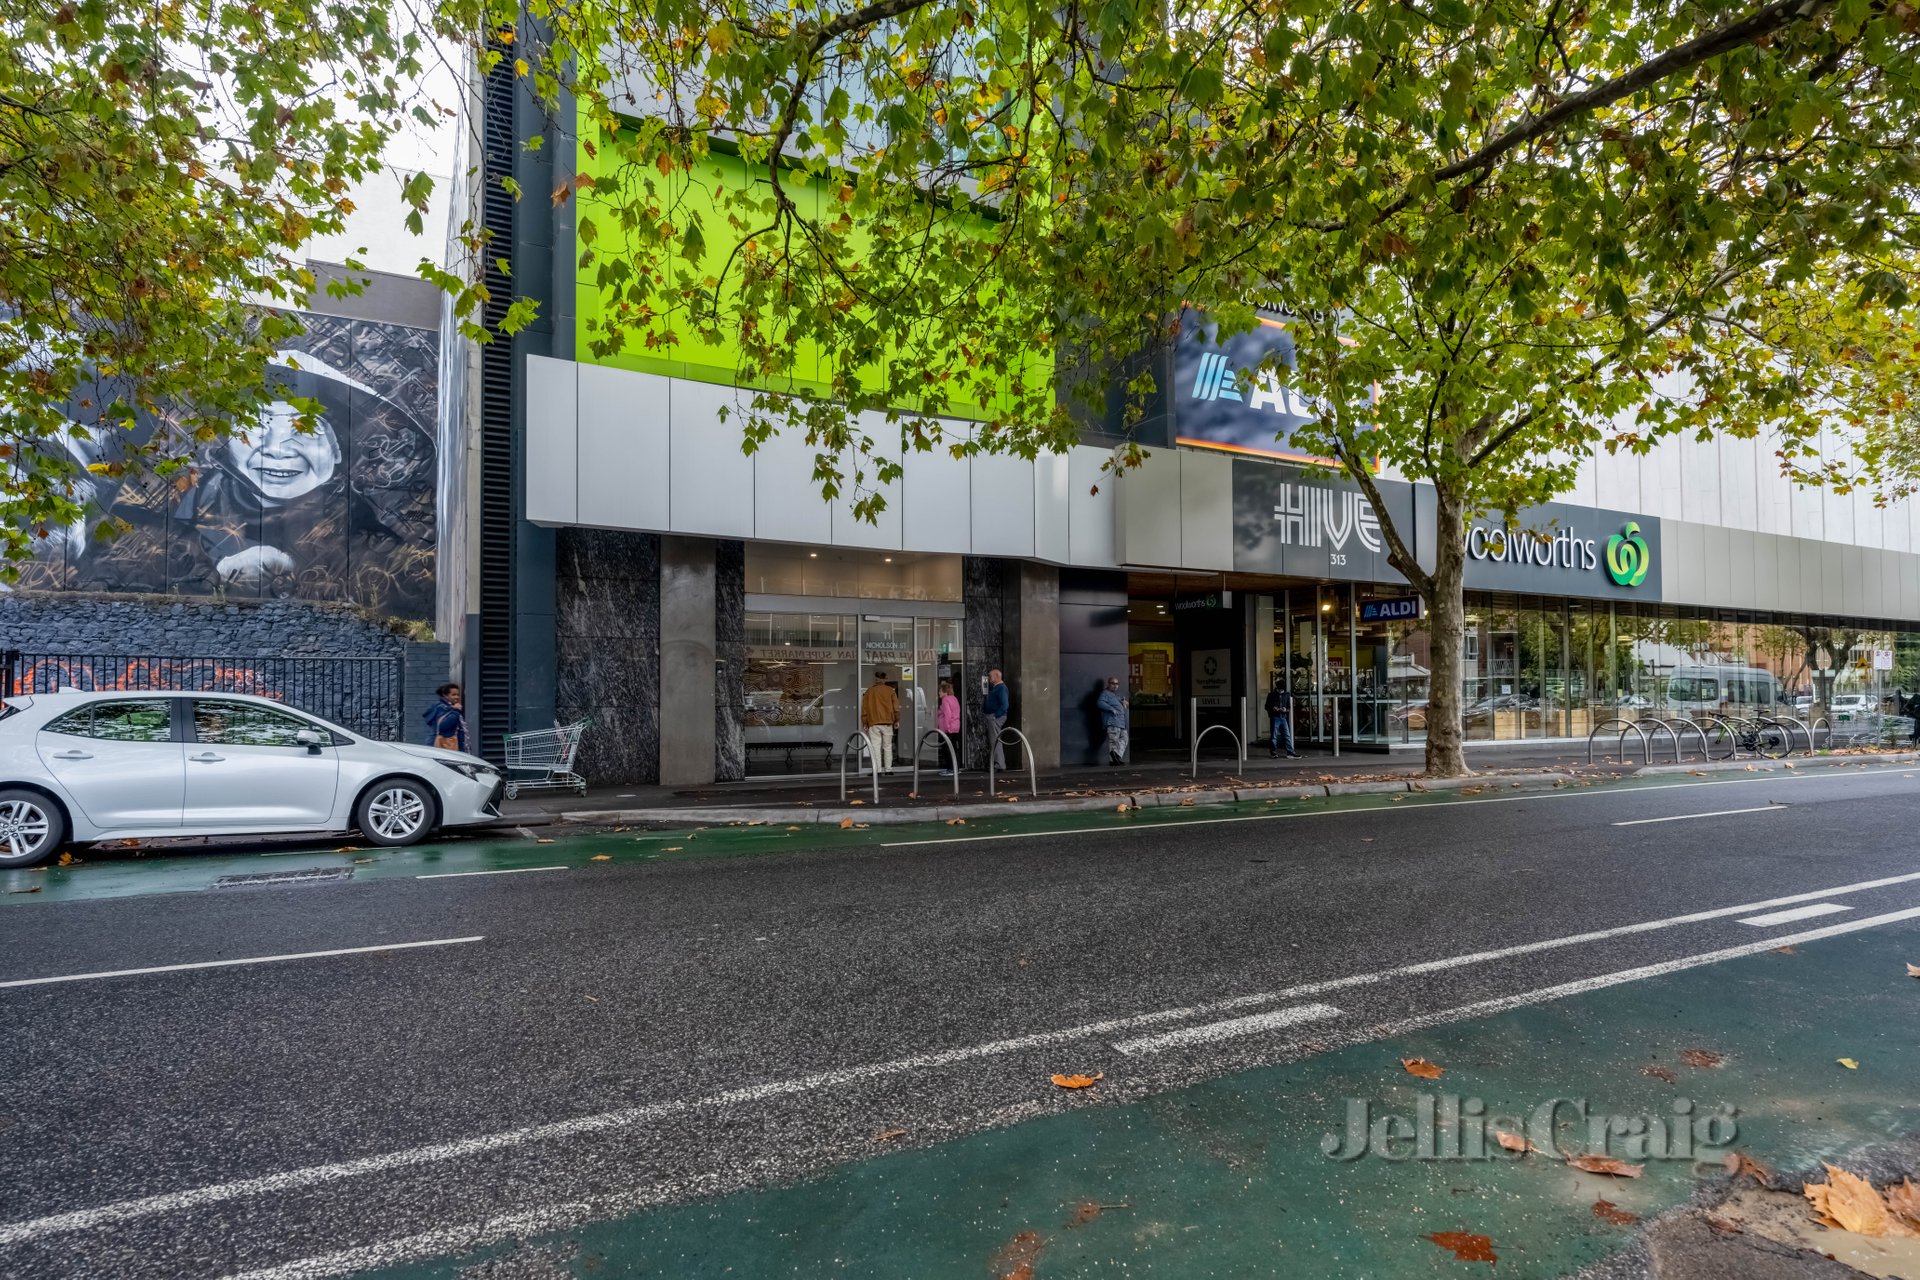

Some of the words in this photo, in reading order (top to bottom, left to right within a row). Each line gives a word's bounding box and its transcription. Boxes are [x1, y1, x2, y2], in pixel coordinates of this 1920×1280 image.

[1273, 482, 1381, 553] HIVE
[1330, 553, 1347, 567] 313
[1465, 526, 1597, 571] oolworths
[1379, 601, 1417, 617] ALDI
